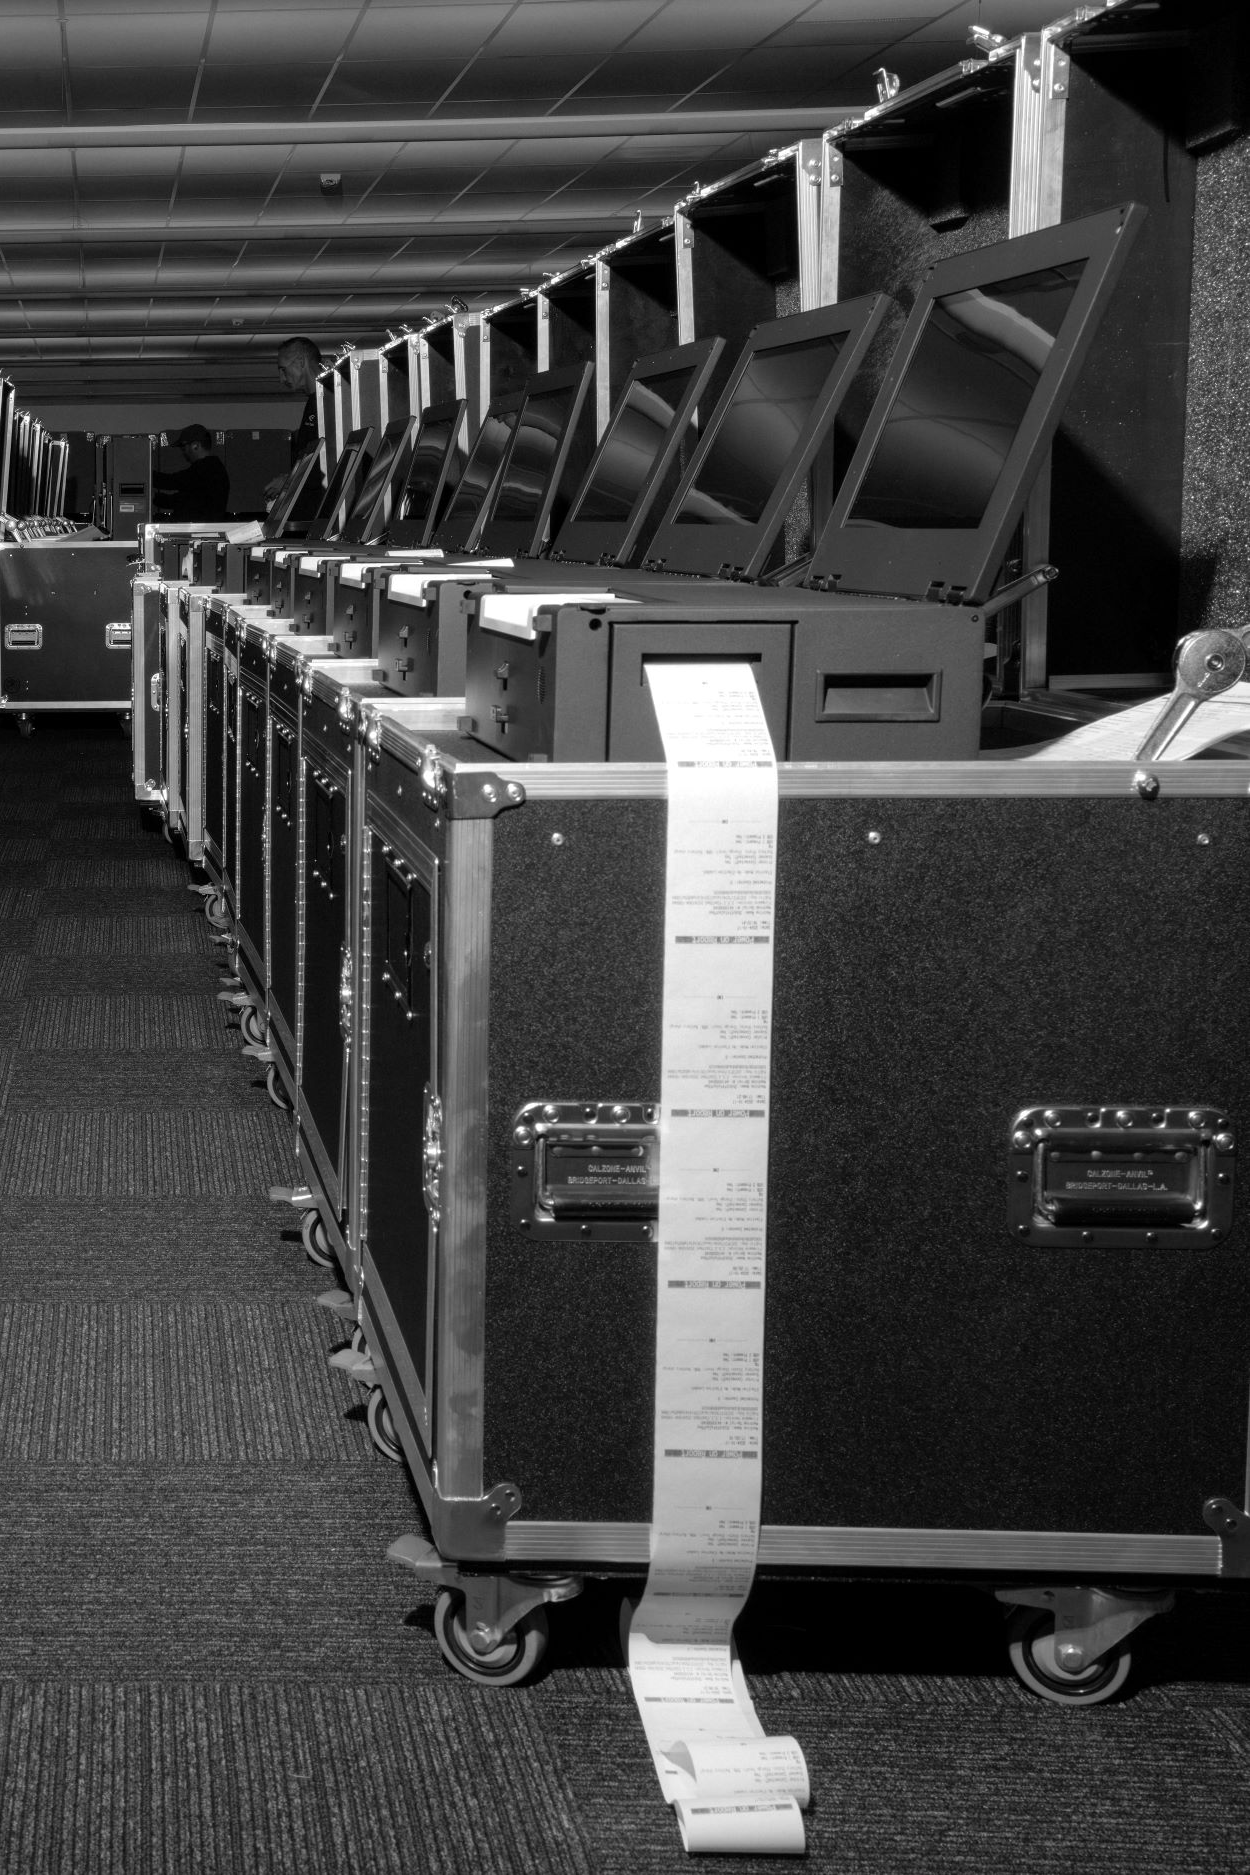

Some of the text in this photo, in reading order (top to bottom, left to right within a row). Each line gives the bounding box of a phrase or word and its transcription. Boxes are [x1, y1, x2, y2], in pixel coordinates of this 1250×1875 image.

[567, 1176, 647, 1185] BRIDGEPORT-DALLAS
[685, 1281, 708, 1289] Report
[726, 1281, 746, 1289] Power
[709, 1805, 734, 1813] Report
[754, 1805, 776, 1813] Power
